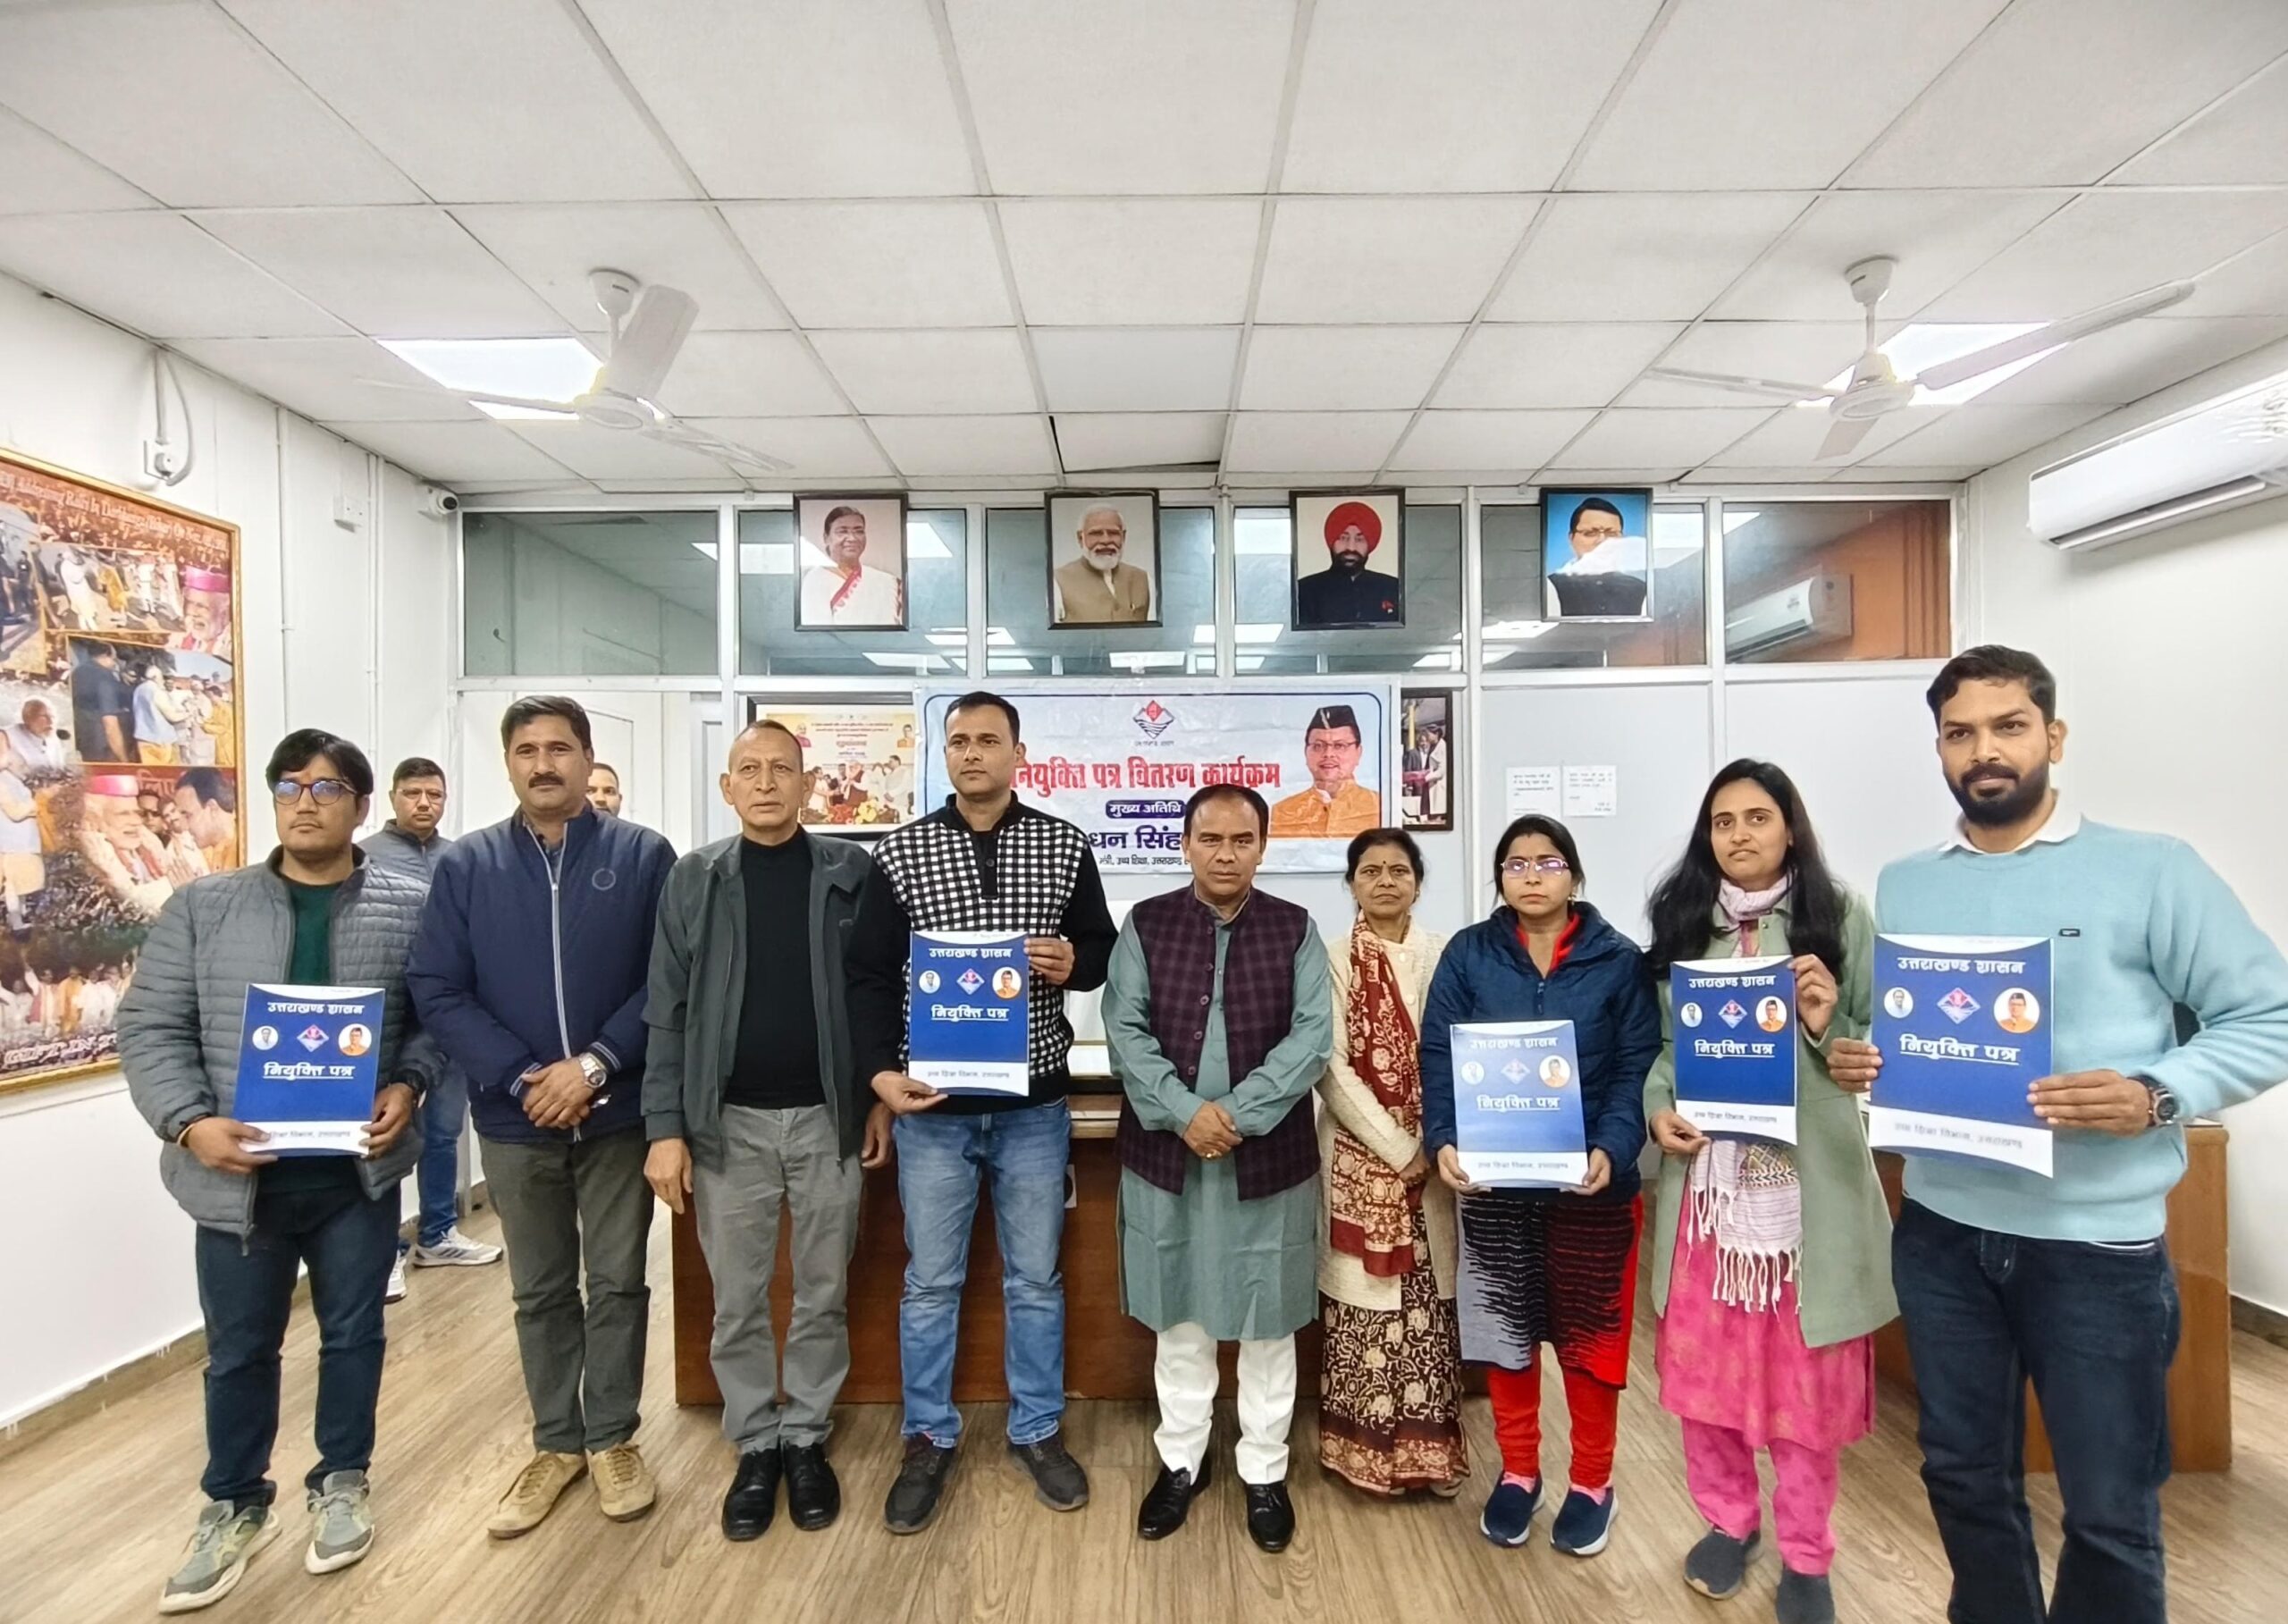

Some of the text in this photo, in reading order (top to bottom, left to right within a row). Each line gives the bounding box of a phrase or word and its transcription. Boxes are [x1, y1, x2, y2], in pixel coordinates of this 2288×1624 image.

[1092, 763, 1122, 788] पत्र
[1127, 756, 1196, 788] वितरण
[1109, 802, 1182, 817] मुख्य अतिथि
[1089, 824, 1182, 851] धन सिंह
[980, 948, 1013, 958] शासन
[1974, 959, 2026, 975] शासन
[1740, 975, 1776, 989] शासन
[327, 1004, 365, 1015] शासन
[931, 1004, 1009, 1022] नियुक्ति पत्र
[1695, 1039, 1775, 1058] नियुक्ति पत्र
[1899, 1033, 2020, 1063] नियुक्ति पत्र
[263, 1061, 356, 1080] नियुक्ति पत्र
